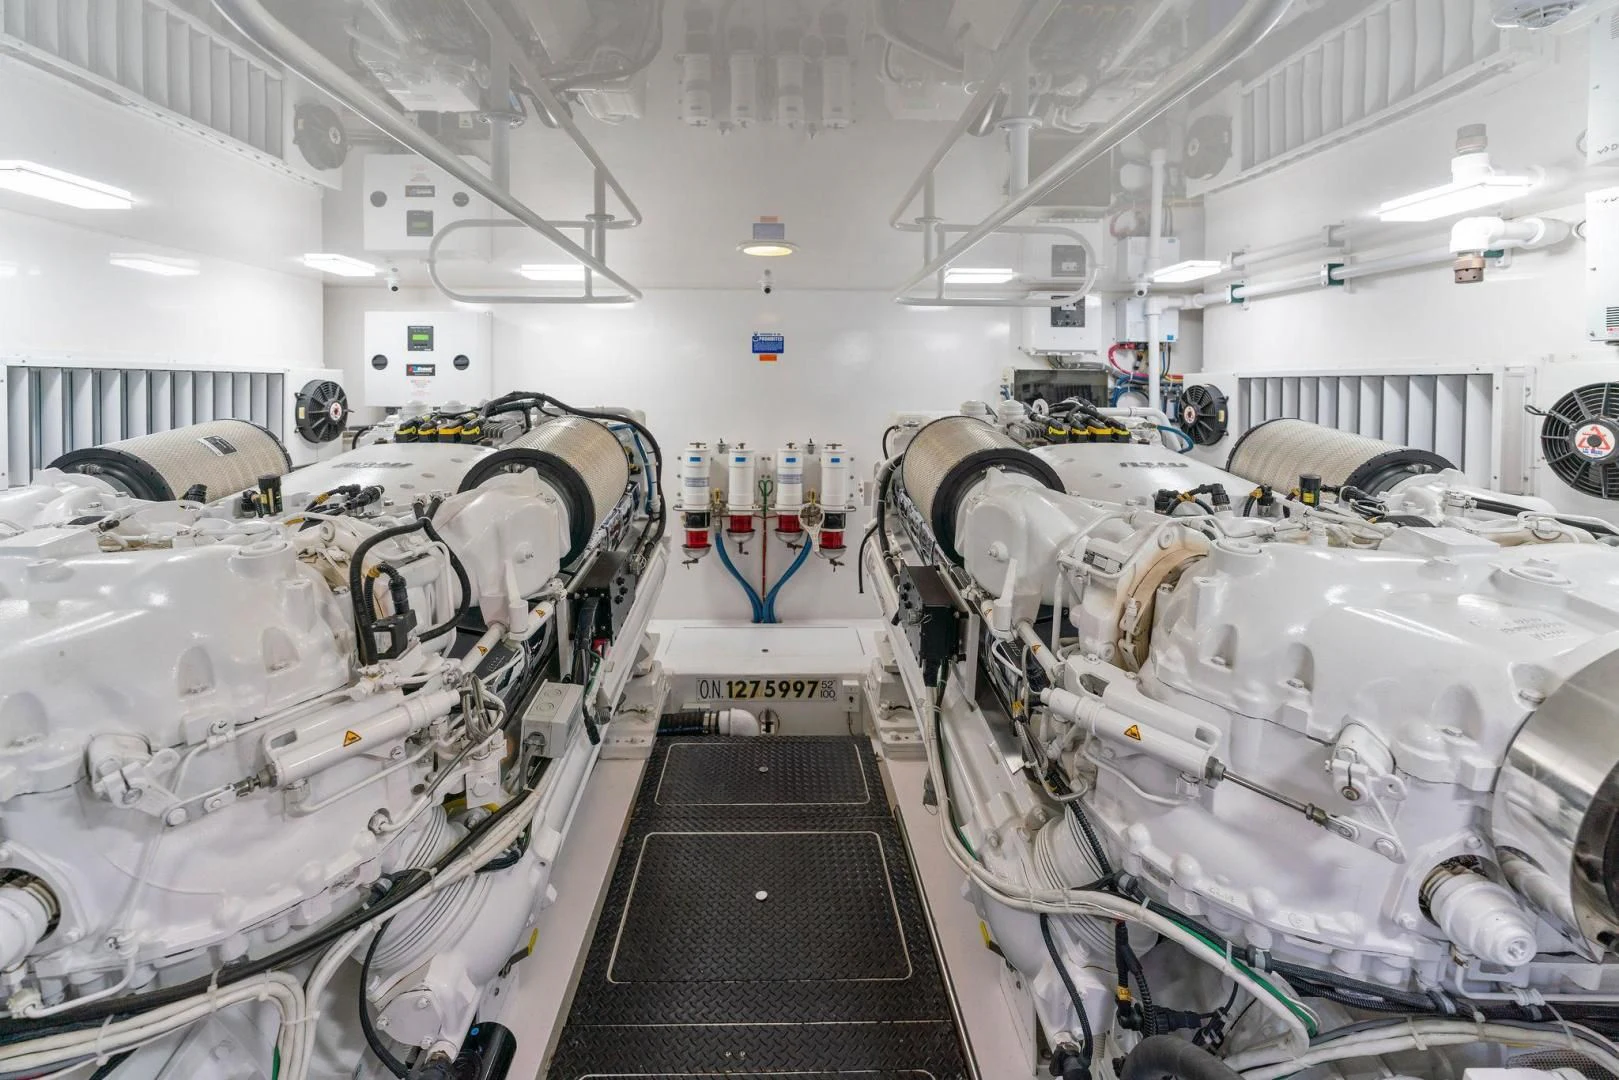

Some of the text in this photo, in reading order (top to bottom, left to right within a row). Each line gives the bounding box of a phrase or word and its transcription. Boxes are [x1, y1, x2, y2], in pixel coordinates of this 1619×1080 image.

[699, 679, 819, 699] O.N. 1275997
[821, 680, 833, 689] 52
[820, 689, 836, 699] 100
